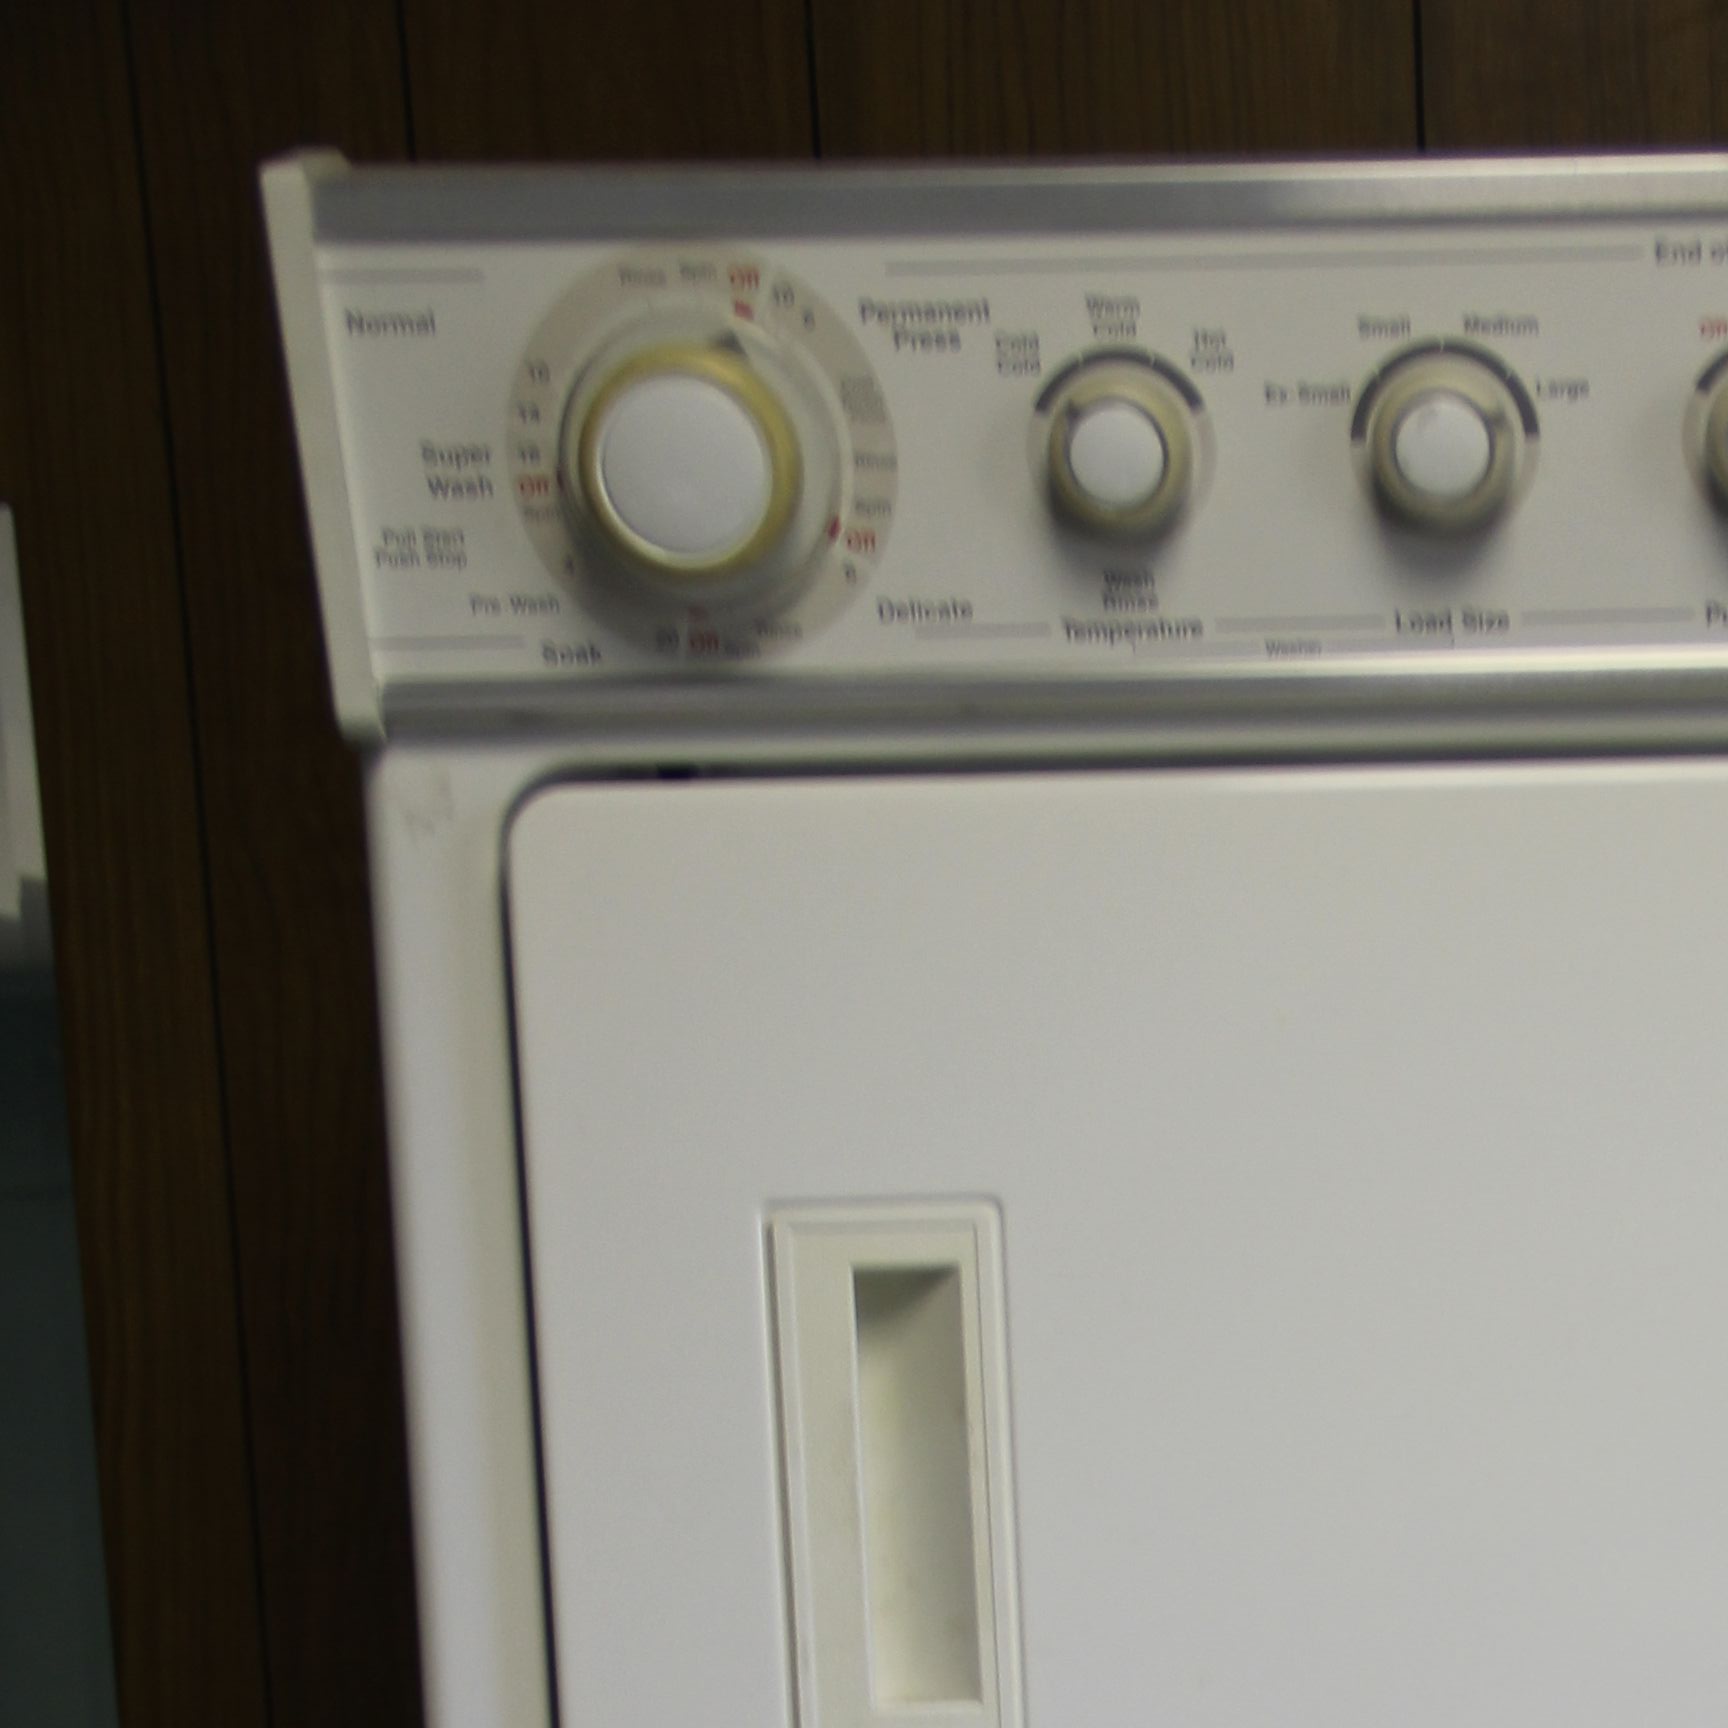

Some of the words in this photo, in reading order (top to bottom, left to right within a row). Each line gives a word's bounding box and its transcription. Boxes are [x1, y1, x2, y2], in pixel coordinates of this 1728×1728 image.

[1654, 235, 1701, 265] End
[345, 307, 435, 338] Normal
[857, 297, 990, 327] Permanent
[1358, 311, 1411, 338] Small
[1462, 310, 1540, 337] Medium
[892, 322, 961, 353] Press
[1535, 377, 1590, 404] Large
[420, 439, 492, 471] Super
[425, 473, 495, 502] Wash
[381, 524, 418, 548] Pull
[421, 523, 466, 548] Start
[373, 547, 421, 570] Push
[423, 547, 469, 573] Stop
[877, 595, 973, 625] Delicate
[1395, 605, 1451, 635] Load
[1461, 603, 1510, 634] Size
[1061, 614, 1203, 646] Temperature
[540, 639, 602, 668] Soak
